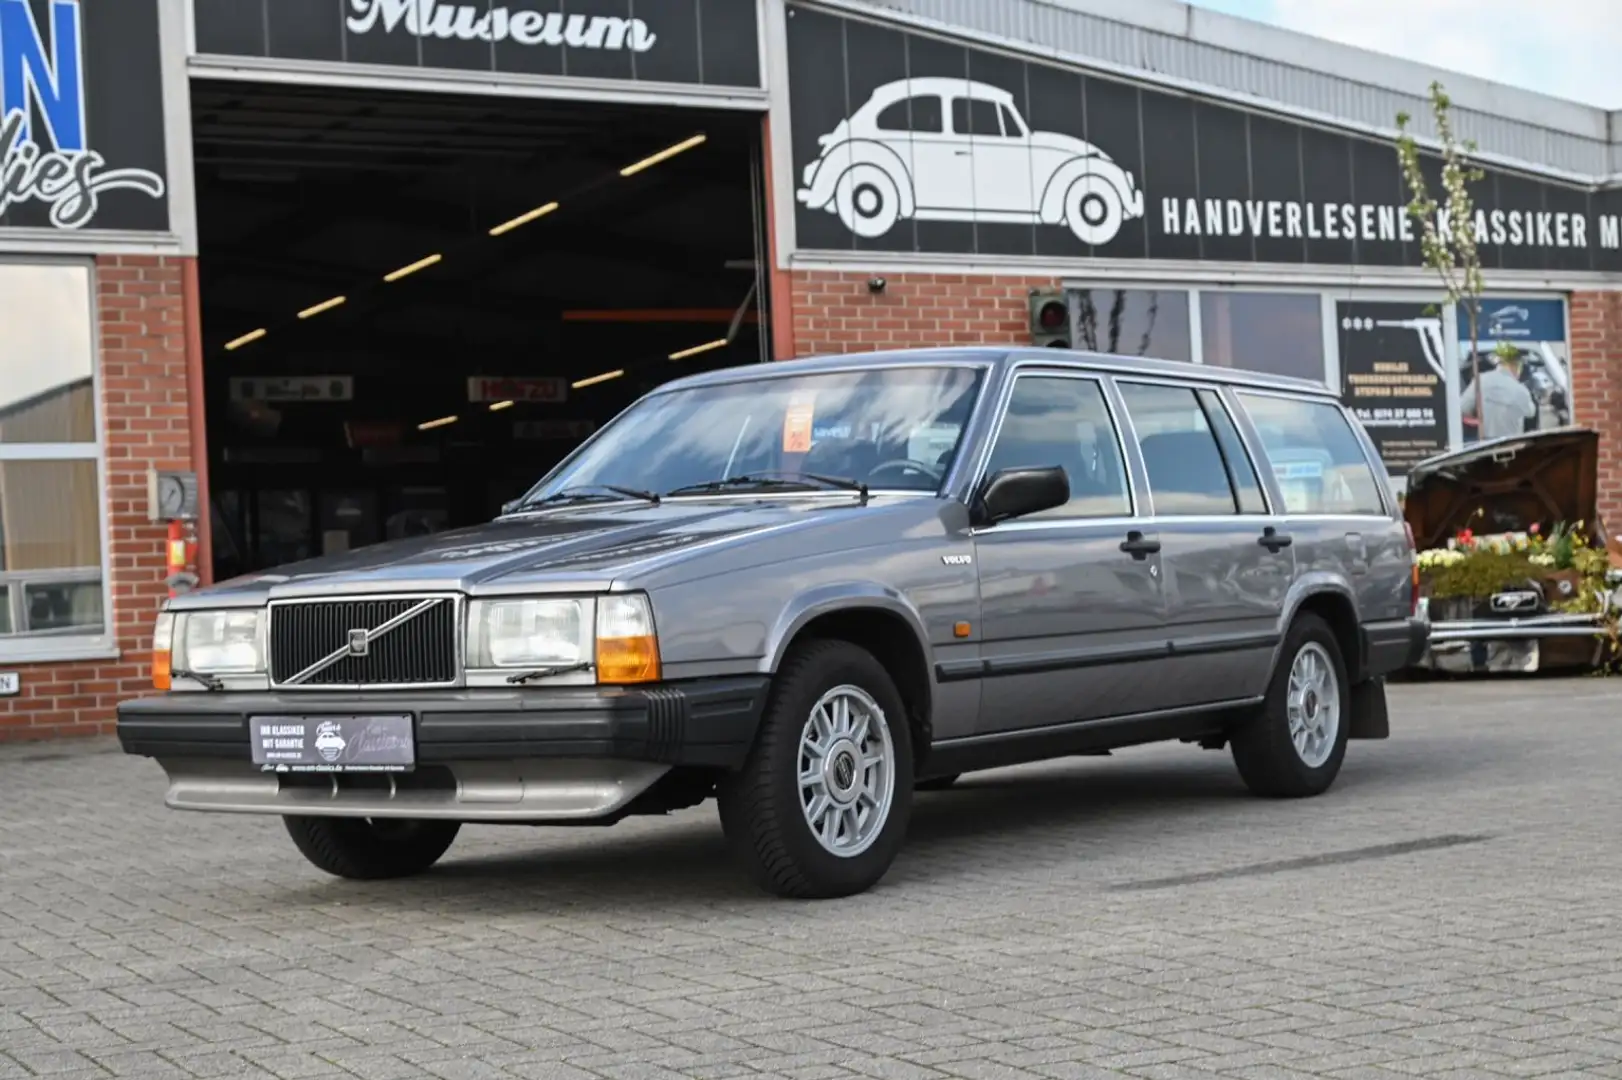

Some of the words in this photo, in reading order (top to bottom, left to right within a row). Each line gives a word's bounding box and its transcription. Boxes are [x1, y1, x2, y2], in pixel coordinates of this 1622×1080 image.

[346, 0, 656, 51] Museum
[1162, 197, 1415, 242] HANDVERLESENE
[1436, 207, 1587, 248] KASSIKER
[1599, 214, 1622, 249] M
